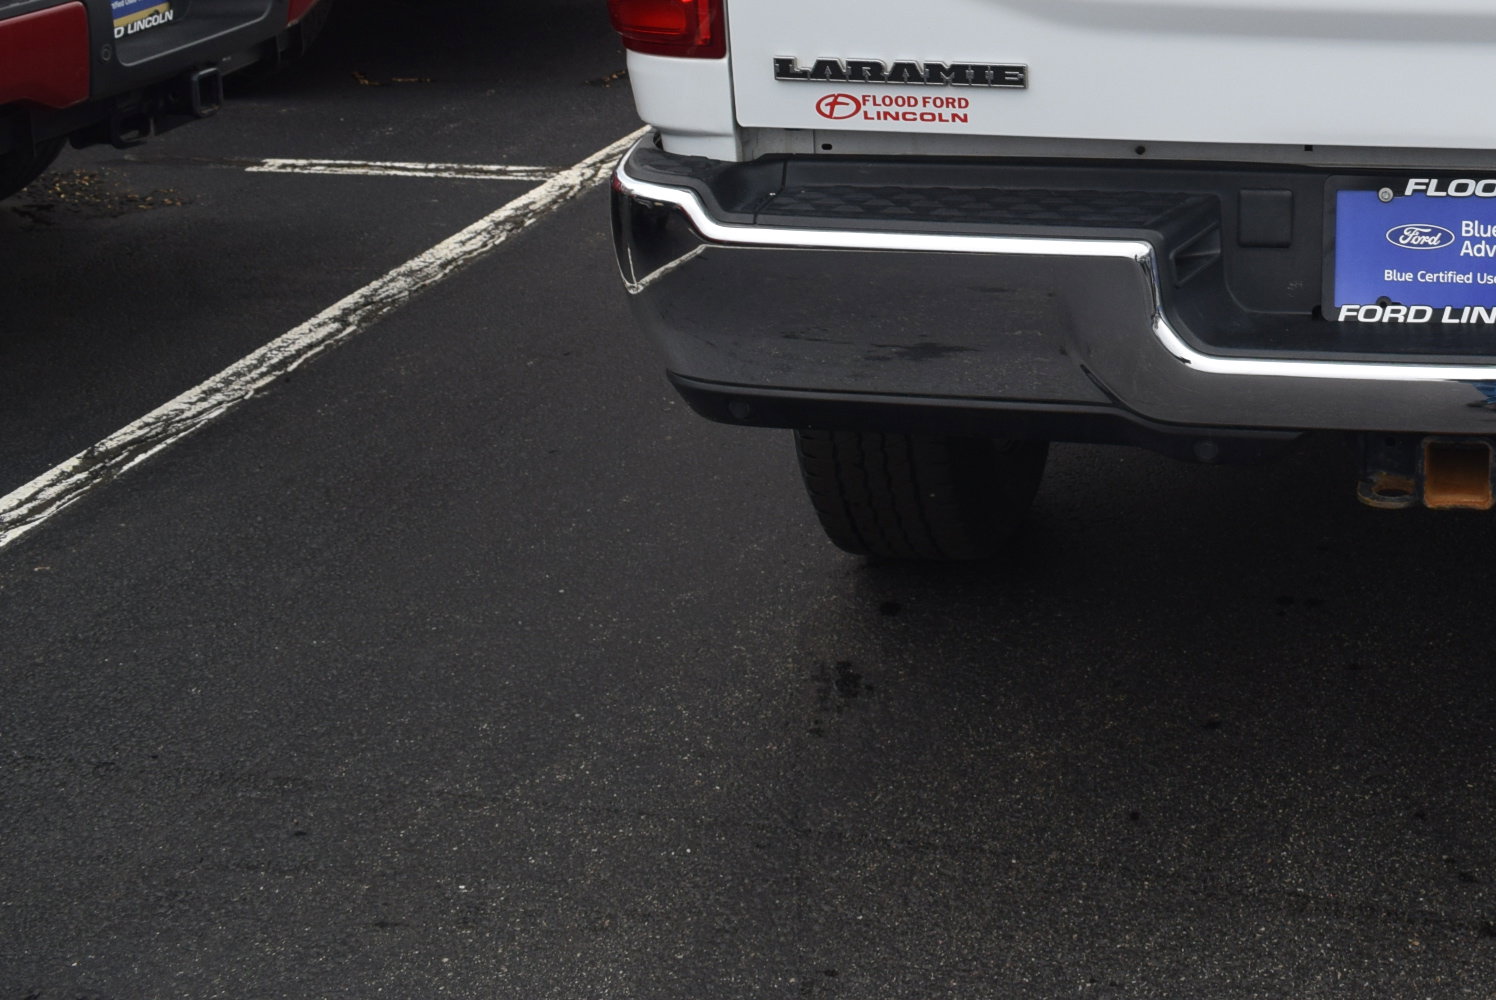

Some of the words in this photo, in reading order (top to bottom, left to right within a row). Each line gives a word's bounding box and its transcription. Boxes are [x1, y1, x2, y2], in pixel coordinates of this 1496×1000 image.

[127, 10, 173, 34] LINCOLN
[773, 55, 1030, 89] LARAMIE
[861, 94, 918, 108] FLOOD
[922, 96, 969, 109] FORD
[863, 110, 969, 123] LINCOLN
[1398, 226, 1442, 246] Ford
[1384, 269, 1413, 282] Blue
[1417, 270, 1473, 284] Certified
[1338, 304, 1433, 323] FORD
